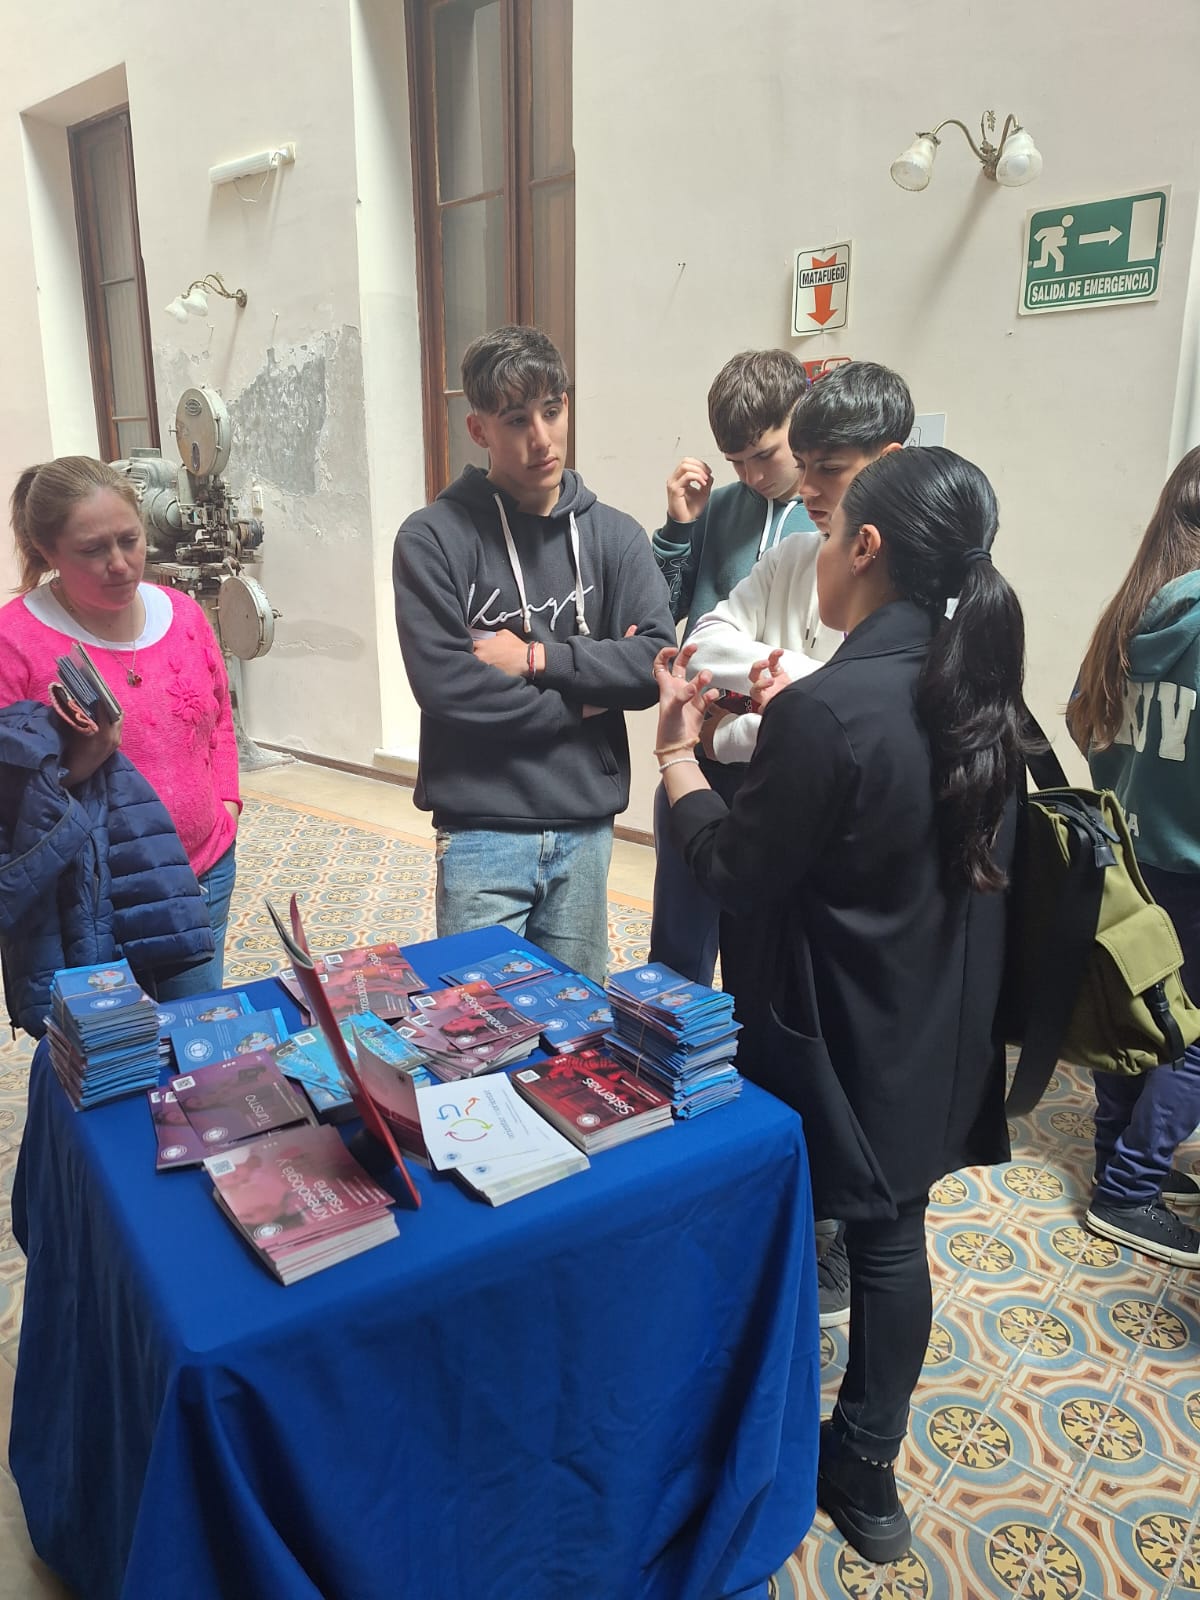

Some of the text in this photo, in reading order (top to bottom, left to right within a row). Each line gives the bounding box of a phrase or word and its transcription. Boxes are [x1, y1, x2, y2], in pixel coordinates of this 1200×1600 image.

[802, 266, 845, 286] MATAFUEGO
[1031, 272, 1149, 303] SALIDA DE EMERGENCIA
[245, 1094, 271, 1127] Turismo
[582, 1077, 635, 1115] Sistemas
